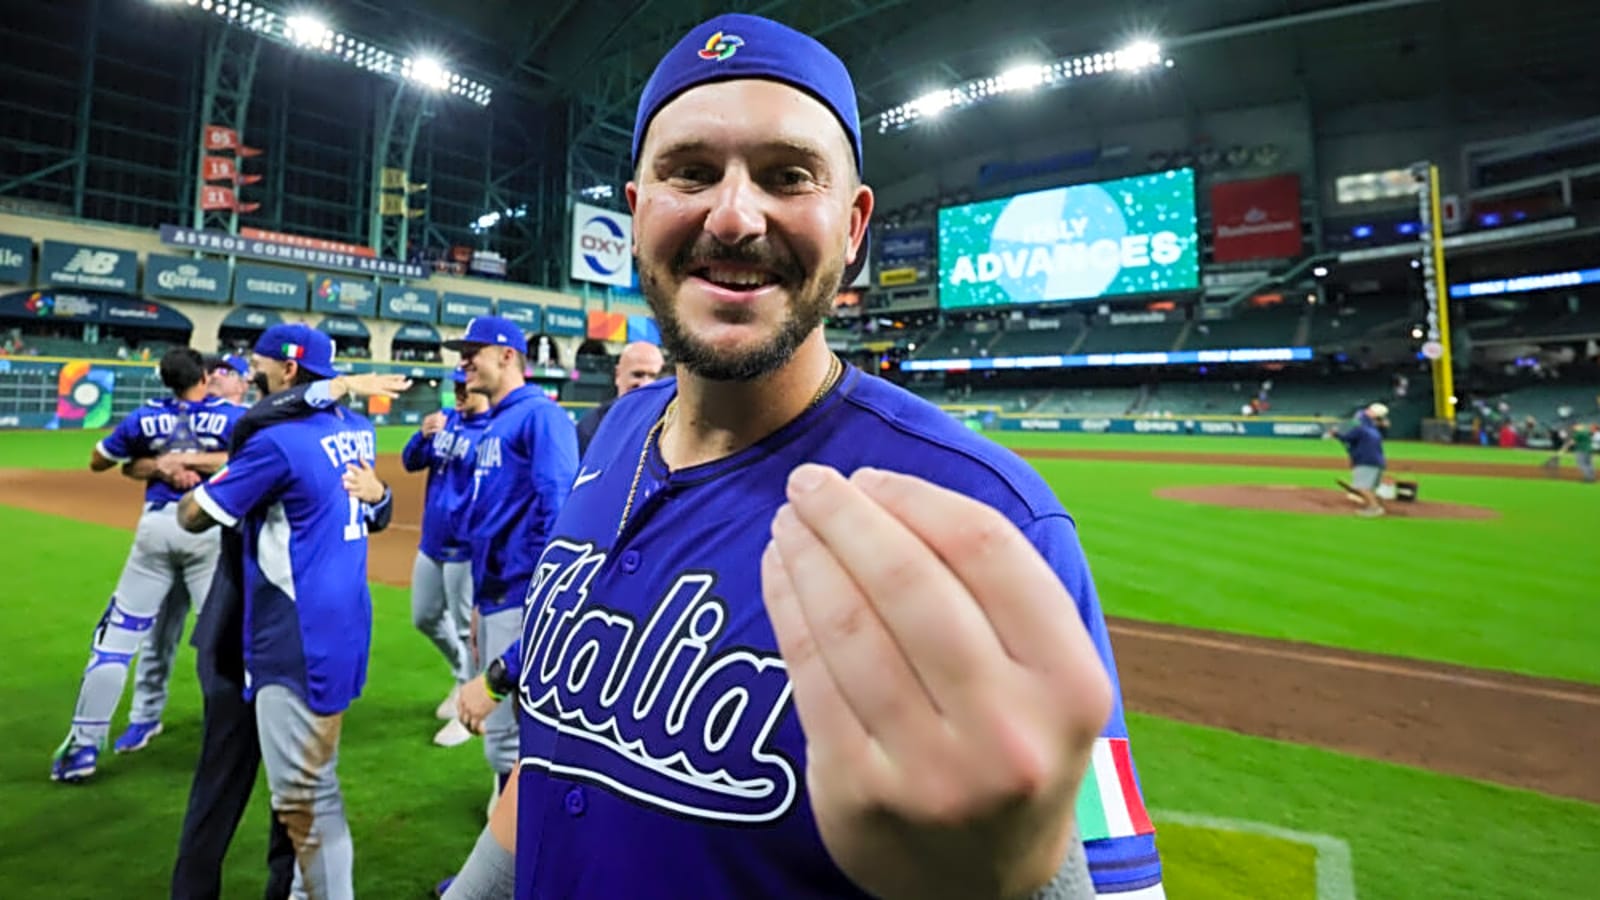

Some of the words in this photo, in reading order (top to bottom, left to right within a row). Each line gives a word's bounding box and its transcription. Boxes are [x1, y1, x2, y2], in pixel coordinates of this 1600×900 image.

[174, 230, 246, 251] ASTROS
[252, 241, 355, 267] COMMUNITY
[360, 257, 422, 277] LEADERS
[581, 234, 626, 257] OXY
[951, 231, 1182, 284] ADVANCES
[157, 269, 217, 291] Corona
[246, 279, 298, 296] DIRECTV
[518, 538, 797, 823] Italia
